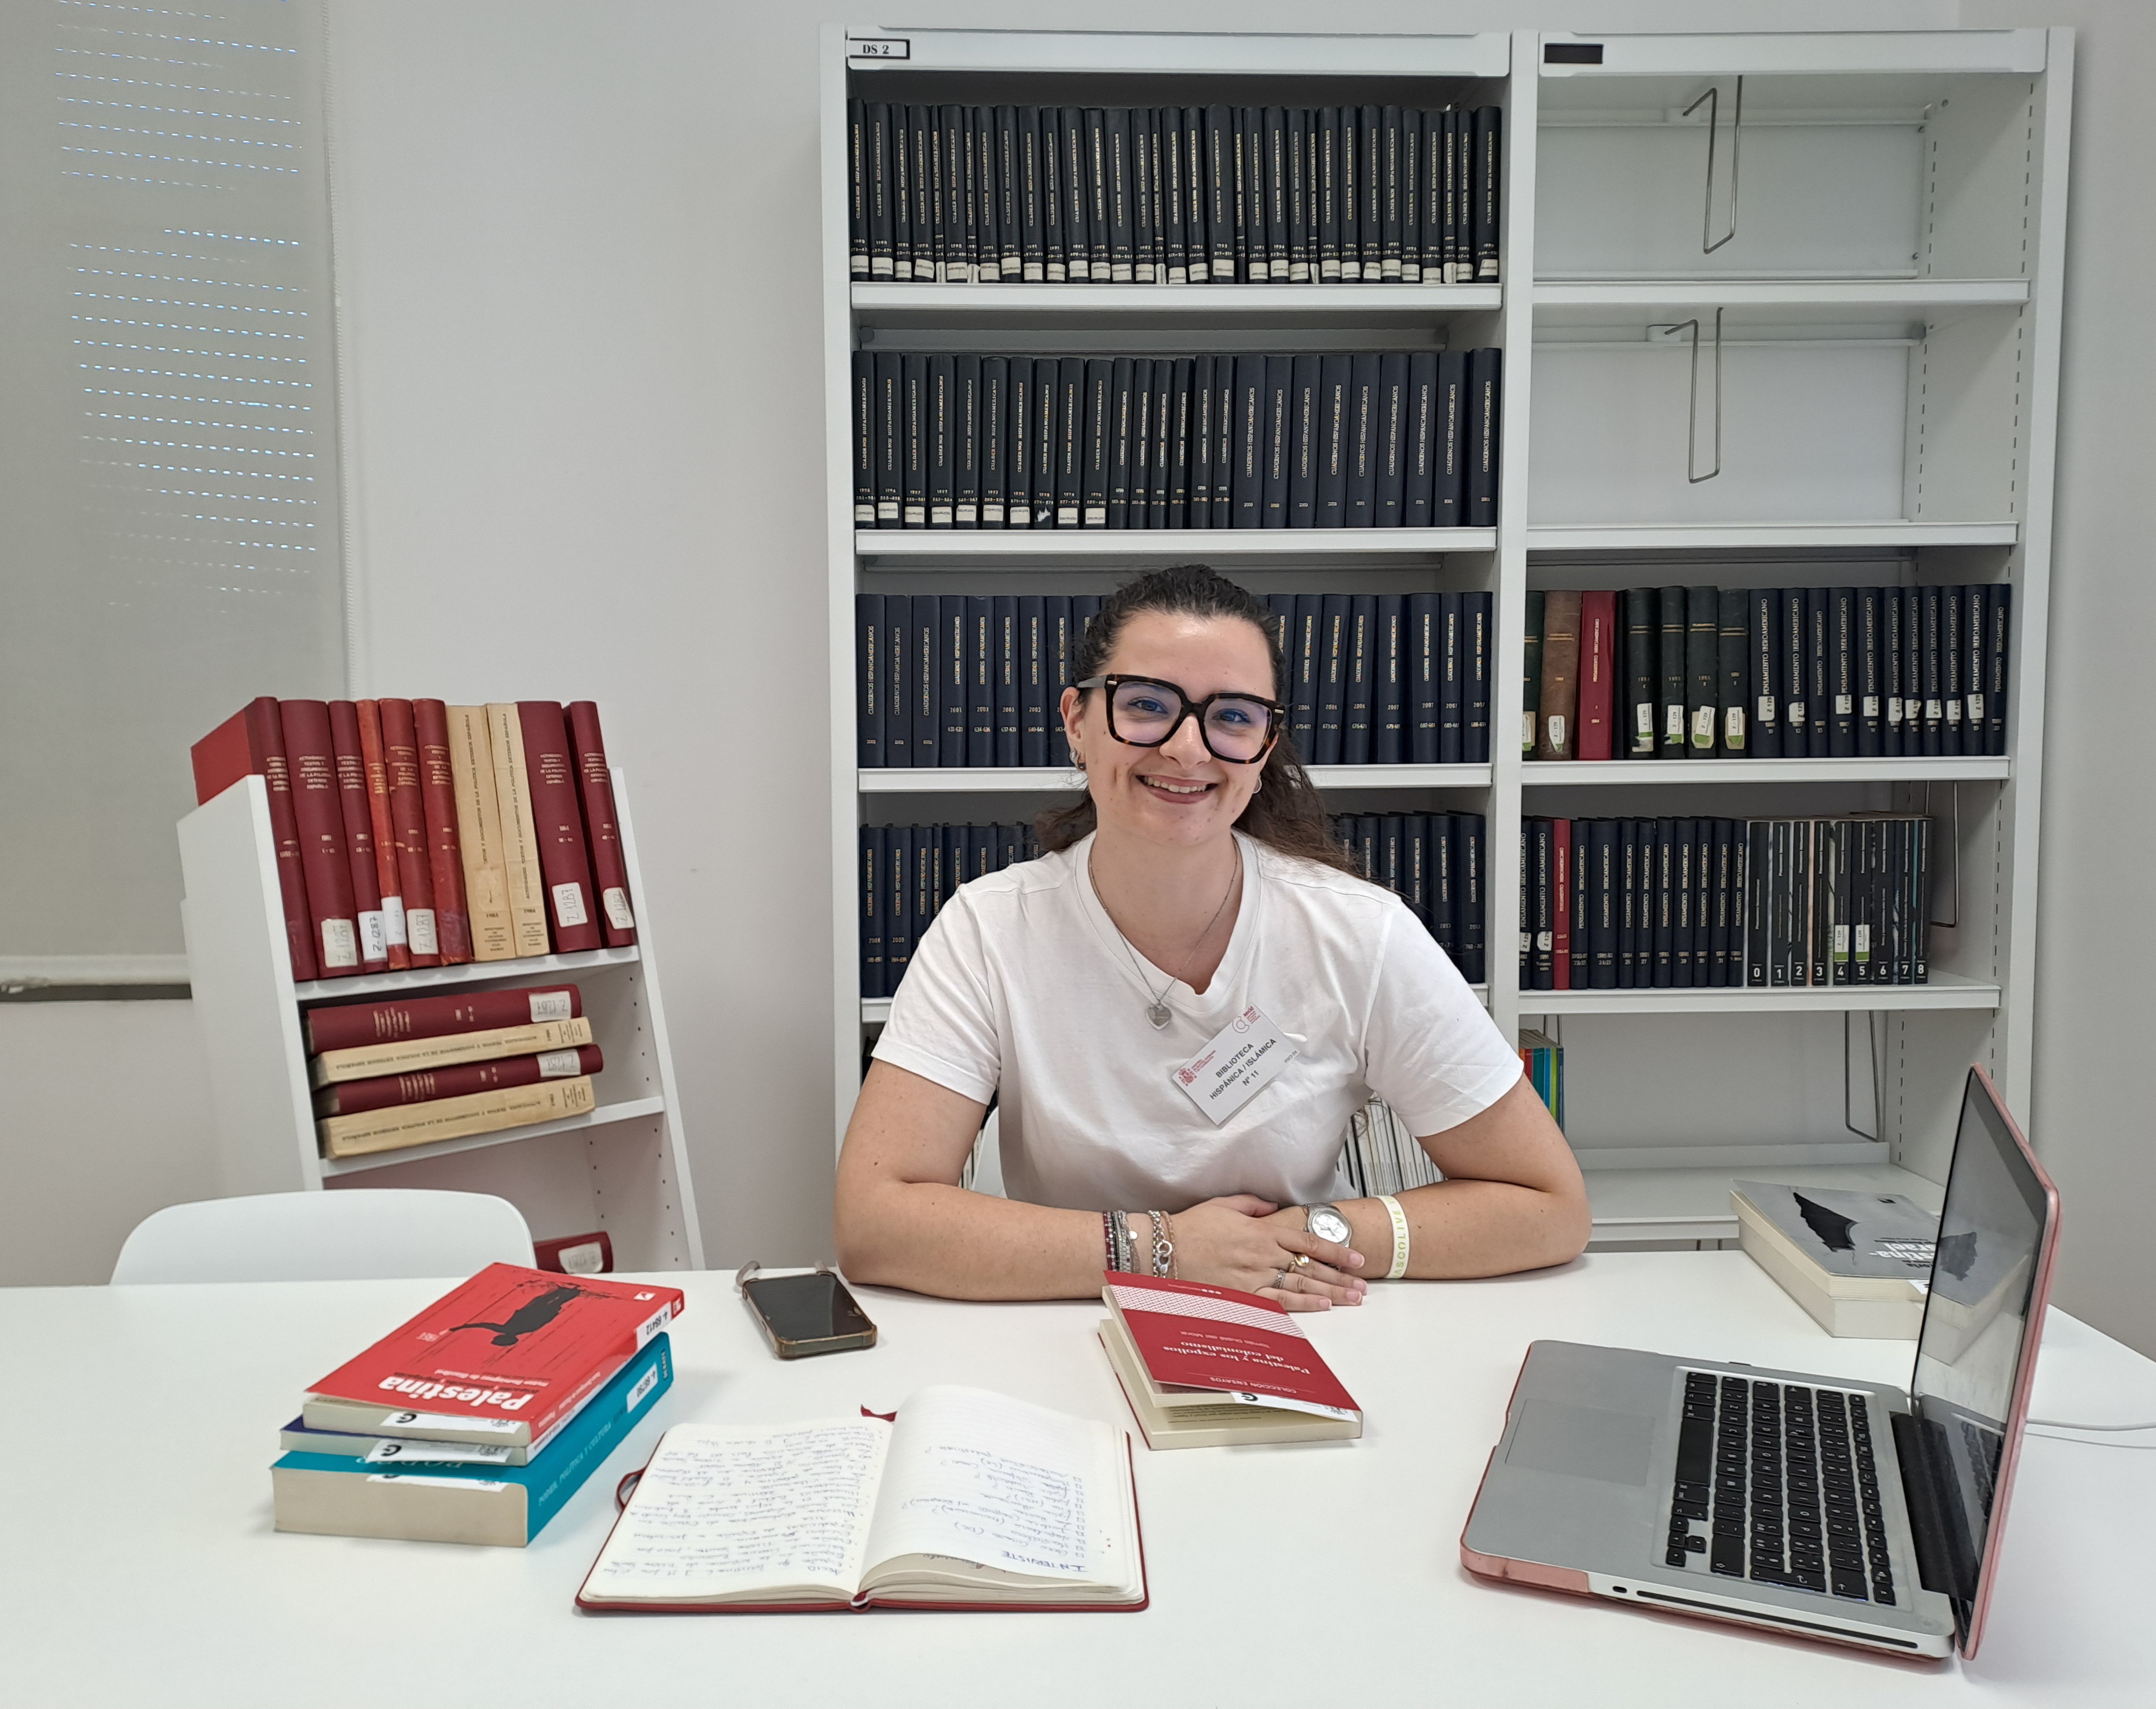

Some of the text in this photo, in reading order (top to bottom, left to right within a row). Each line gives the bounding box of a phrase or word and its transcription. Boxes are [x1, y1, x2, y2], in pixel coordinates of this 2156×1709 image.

[862, 44, 890, 54] DS 2
[1762, 653, 1770, 695] PENSAMIENTO
[1867, 651, 1875, 693] PENSAMIENTO
[1949, 651, 1957, 692] PENSAMIENTO
[1972, 650, 1980, 691] PENSAMIENTO
[562, 889, 575, 909] 1287
[1754, 967, 1761, 978] 0
[1777, 969, 1781, 979] 1
[1796, 966, 1802, 976] 2
[1816, 966, 1823, 977] 3
[1837, 966, 1844, 976] 4
[1859, 966, 1865, 976] 5
[1880, 965, 1886, 975] 6
[1902, 964, 1909, 975] 7
[1917, 964, 1924, 974] 8
[1216, 1043, 1254, 1078] BIBLIOTECA
[1209, 1070, 1244, 1100] HISPÁNICA
[1246, 1039, 1277, 1068] ISLÁMICA
[1252, 1070, 1259, 1079] 11
[1163, 1345, 1216, 1358] expolios
[1180, 1340, 1284, 1363] del colonialismo
[1219, 1352, 1240, 1362] los
[1253, 1356, 1310, 1375] Palestina
[1209, 1376, 1297, 1395] COLECCIÓN ENSAYOS
[377, 1376, 534, 1411] Palestina
[1001, 1551, 1088, 1573] INTERVISTE
